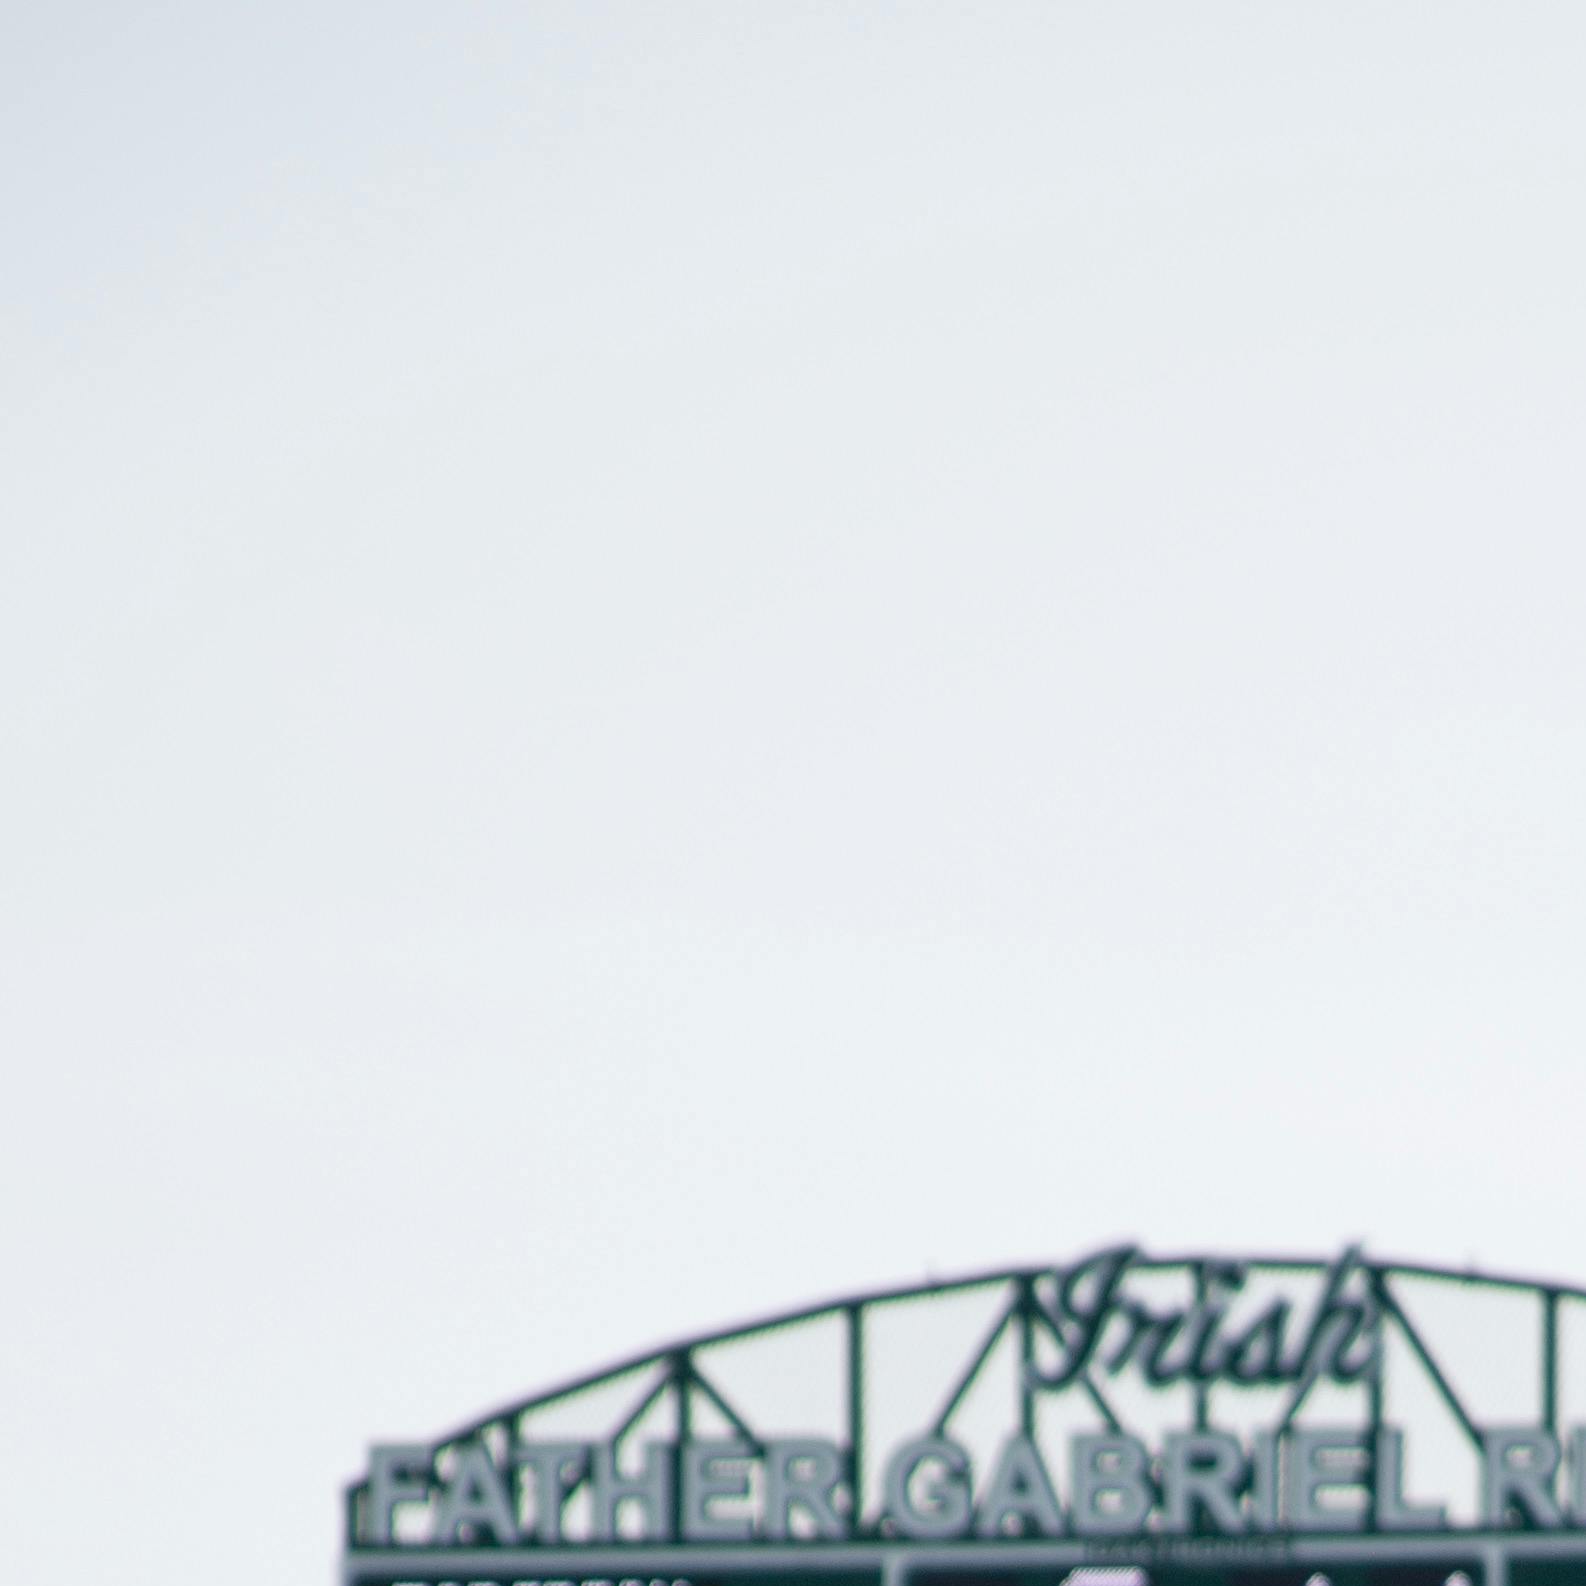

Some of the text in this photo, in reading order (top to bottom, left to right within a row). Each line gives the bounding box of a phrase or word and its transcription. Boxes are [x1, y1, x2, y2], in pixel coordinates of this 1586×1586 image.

[1022, 1240, 1381, 1388] Irish
[366, 1440, 850, 1544] FATHER
[884, 1425, 1448, 1538] GABRIEL
